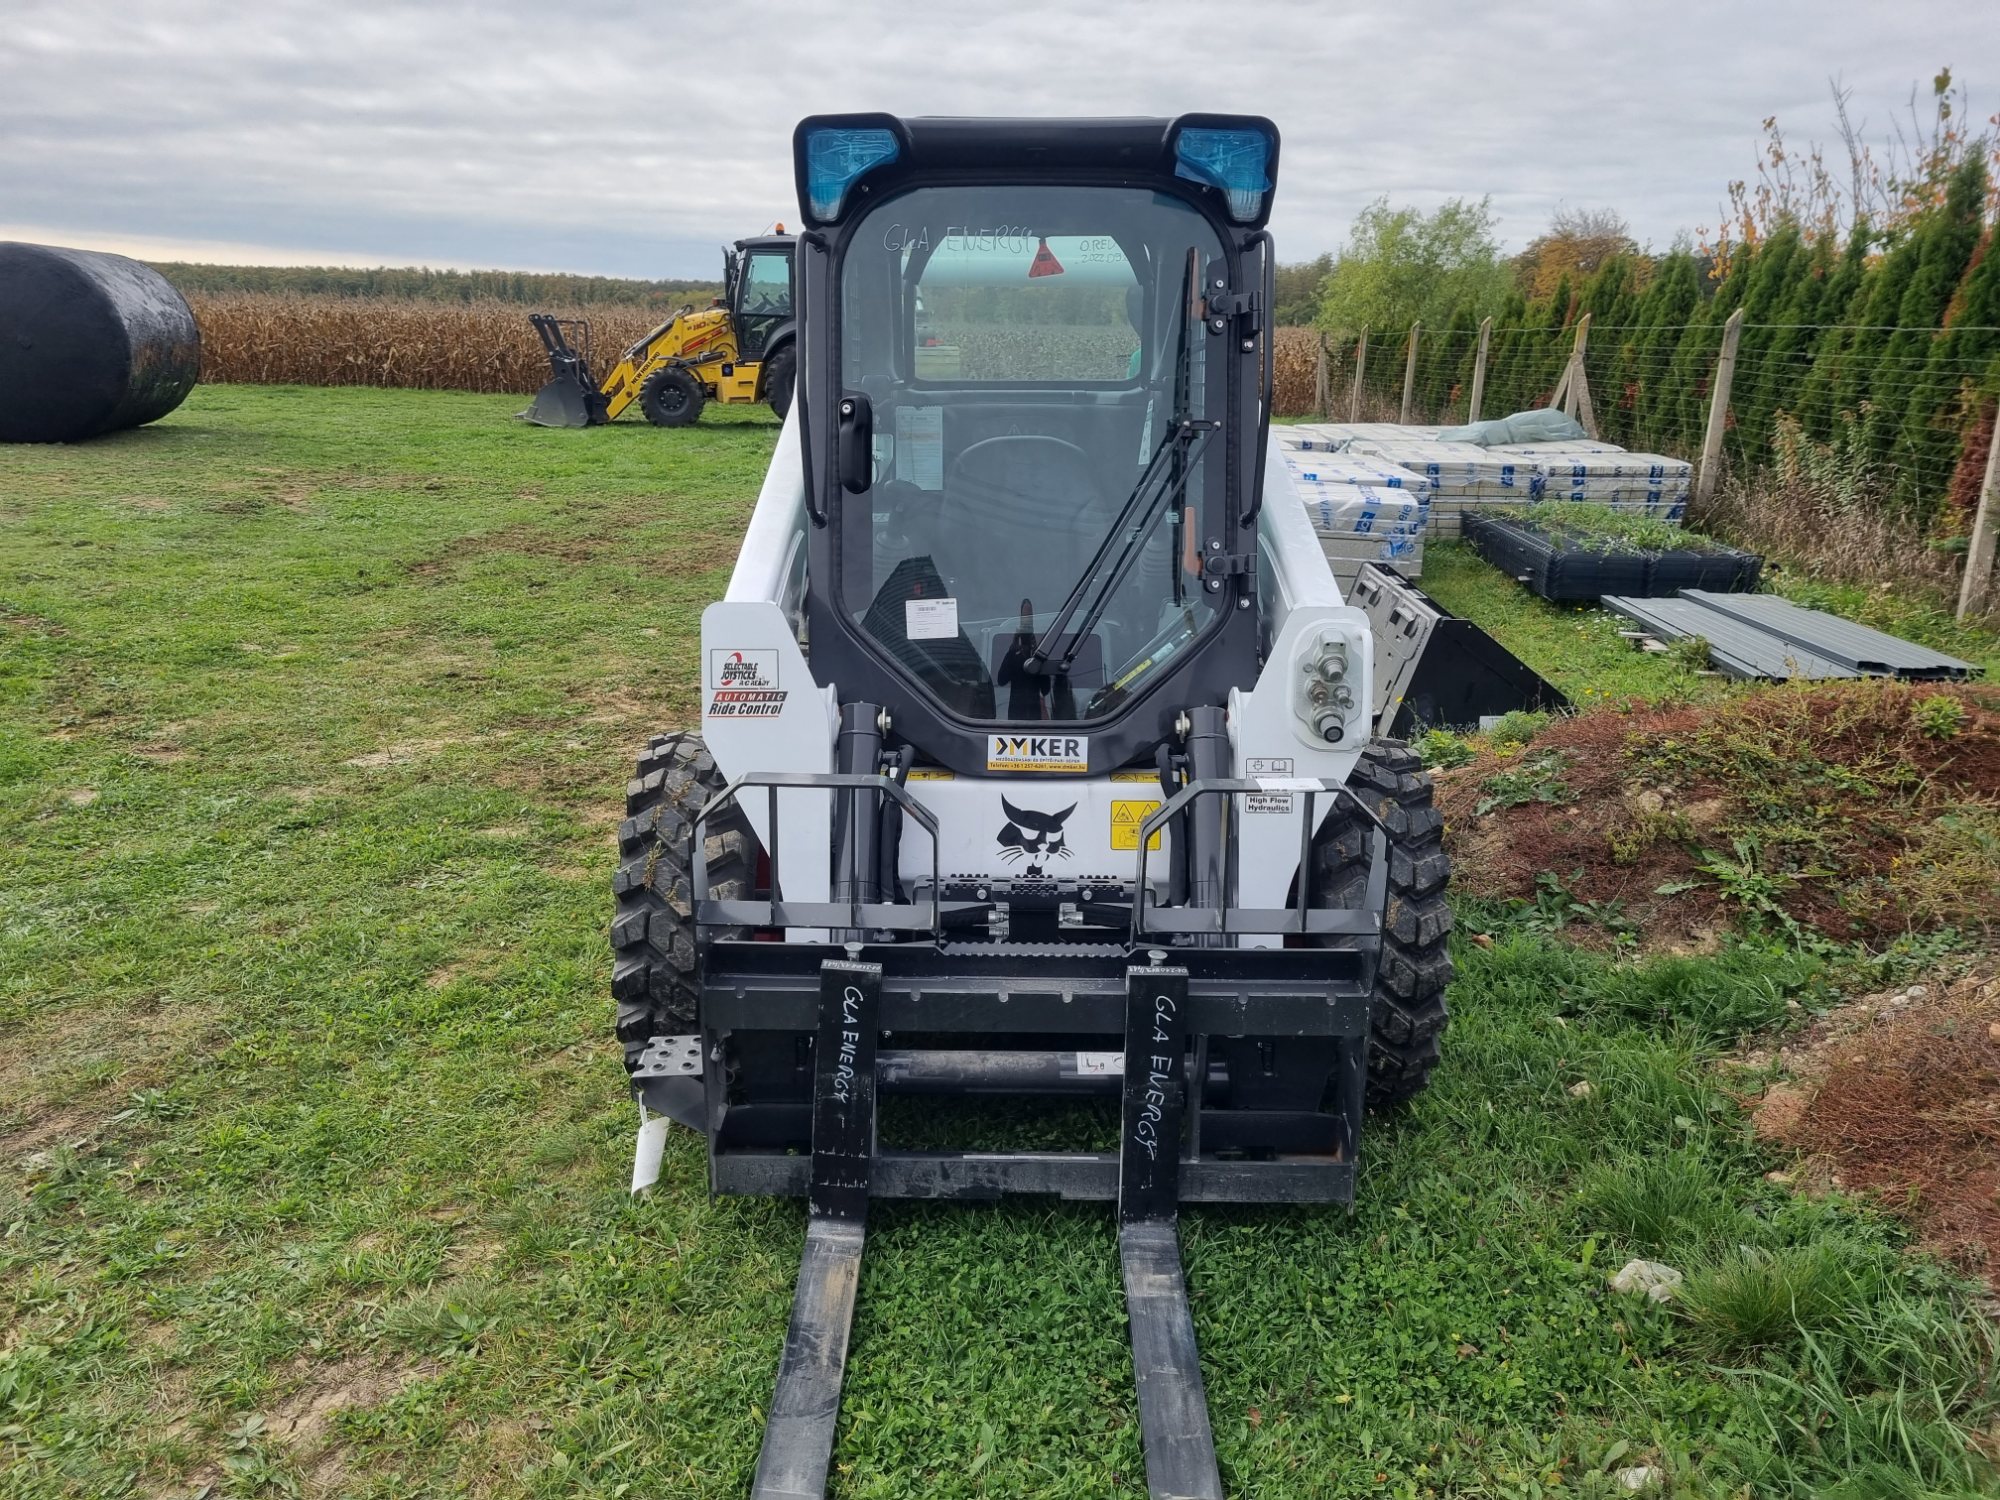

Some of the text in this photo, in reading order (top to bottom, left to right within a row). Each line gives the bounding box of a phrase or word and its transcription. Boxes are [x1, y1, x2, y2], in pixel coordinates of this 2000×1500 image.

[631, 352, 660, 384] NEW HOLLAND
[721, 671, 757, 680] JOYSTICKS
[716, 693, 785, 701] AUTOMATIC
[708, 703, 783, 715] Ride Control
[1248, 804, 1290, 812] Hydraulics
[1152, 995, 1176, 1043] GLA
[833, 986, 864, 1104] GLA ENERGY
[1134, 1055, 1173, 1161] ENERGY
